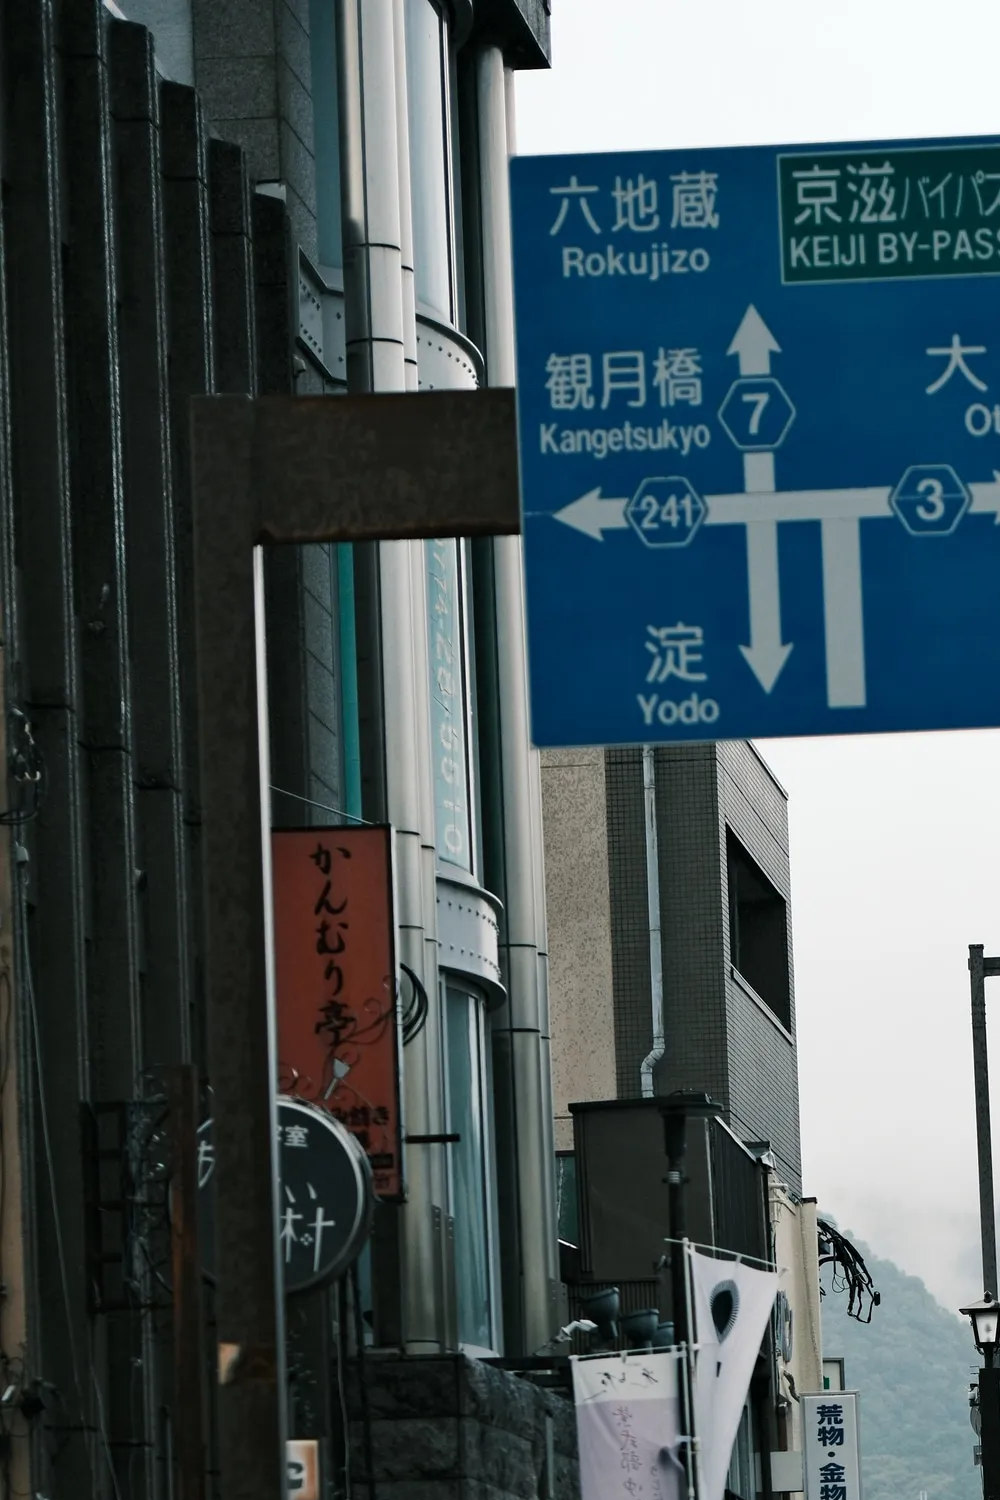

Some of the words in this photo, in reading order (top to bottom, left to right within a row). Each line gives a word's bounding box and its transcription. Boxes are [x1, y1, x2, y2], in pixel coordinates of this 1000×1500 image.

[549, 171, 719, 236] 六地蔵
[562, 246, 710, 281] Rokujizo
[789, 233, 867, 268] KEIJI
[545, 347, 703, 410] 観月橋
[741, 393, 770, 434] 7
[540, 420, 711, 458] Kangetsukyo
[640, 499, 694, 530] 241
[915, 479, 944, 520] 3
[645, 622, 708, 684] 淀
[637, 693, 720, 725] Yodo
[308, 842, 358, 1048] かんむり亭
